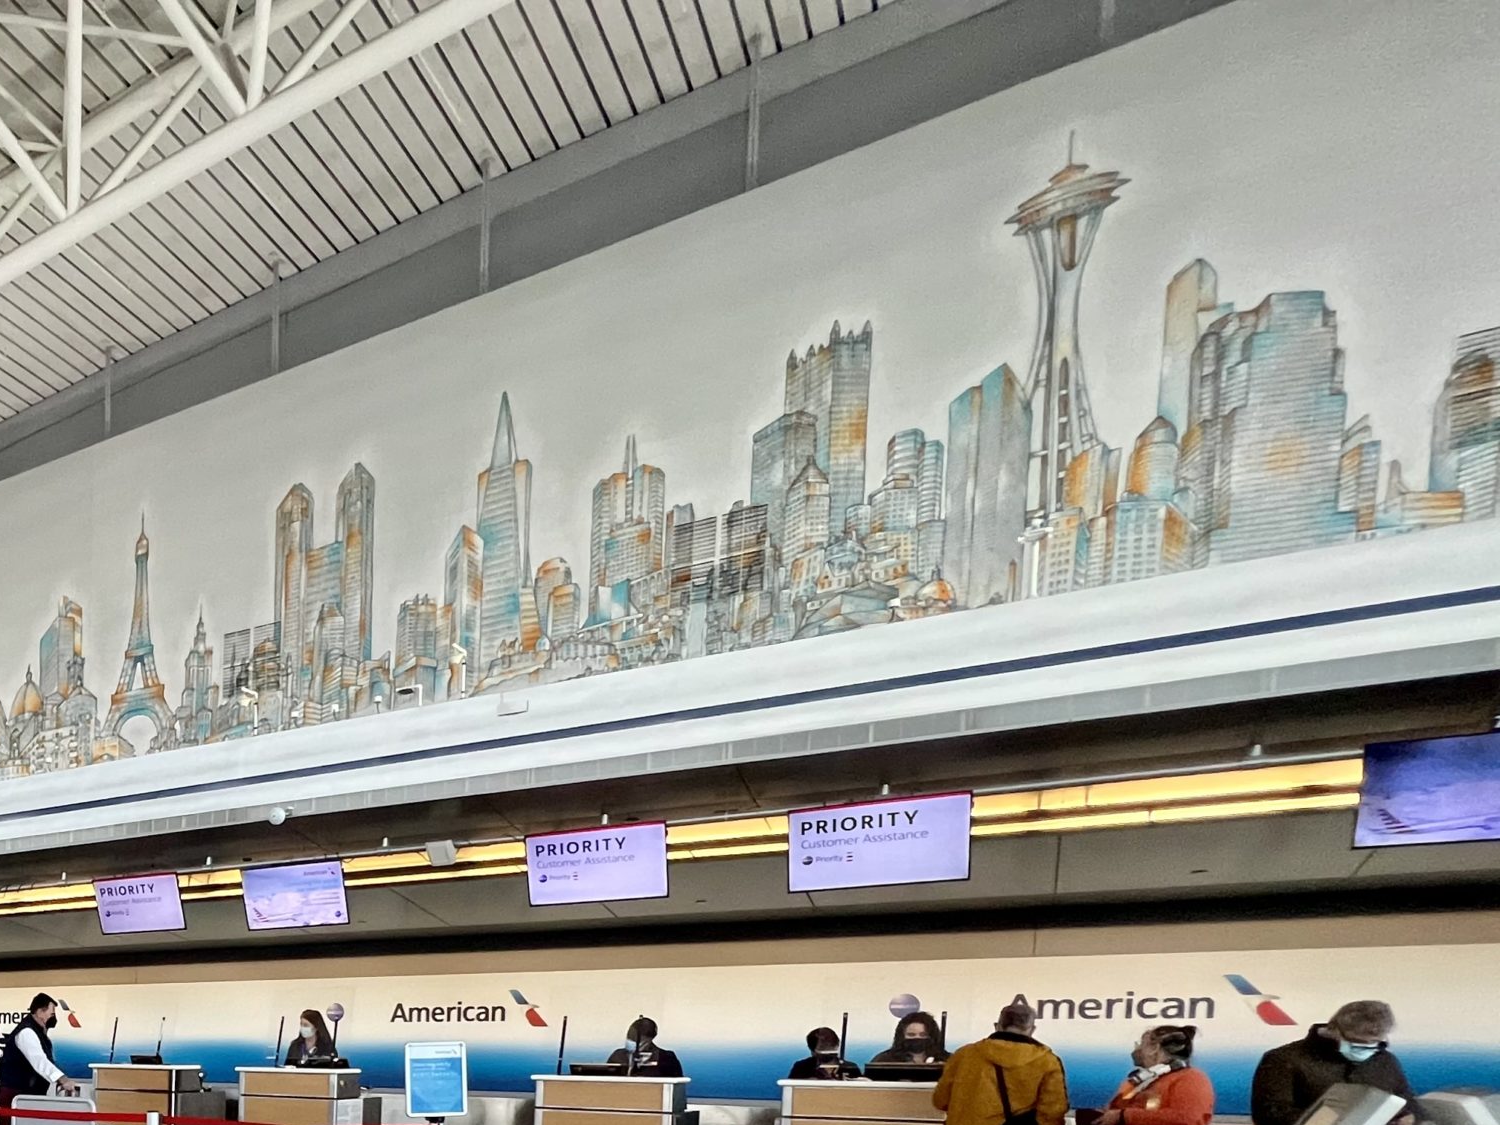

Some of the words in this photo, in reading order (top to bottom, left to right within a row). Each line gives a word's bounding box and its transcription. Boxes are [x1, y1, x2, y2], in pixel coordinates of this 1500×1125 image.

[800, 809, 919, 836] PRIORITY
[535, 836, 627, 858] PRIORITY
[800, 836, 859, 850] Customer
[862, 829, 930, 844] Assistance
[535, 858, 582, 870] Customer
[584, 853, 636, 865] Assistance
[99, 882, 155, 898] PRIORITY
[389, 1001, 506, 1023] American
